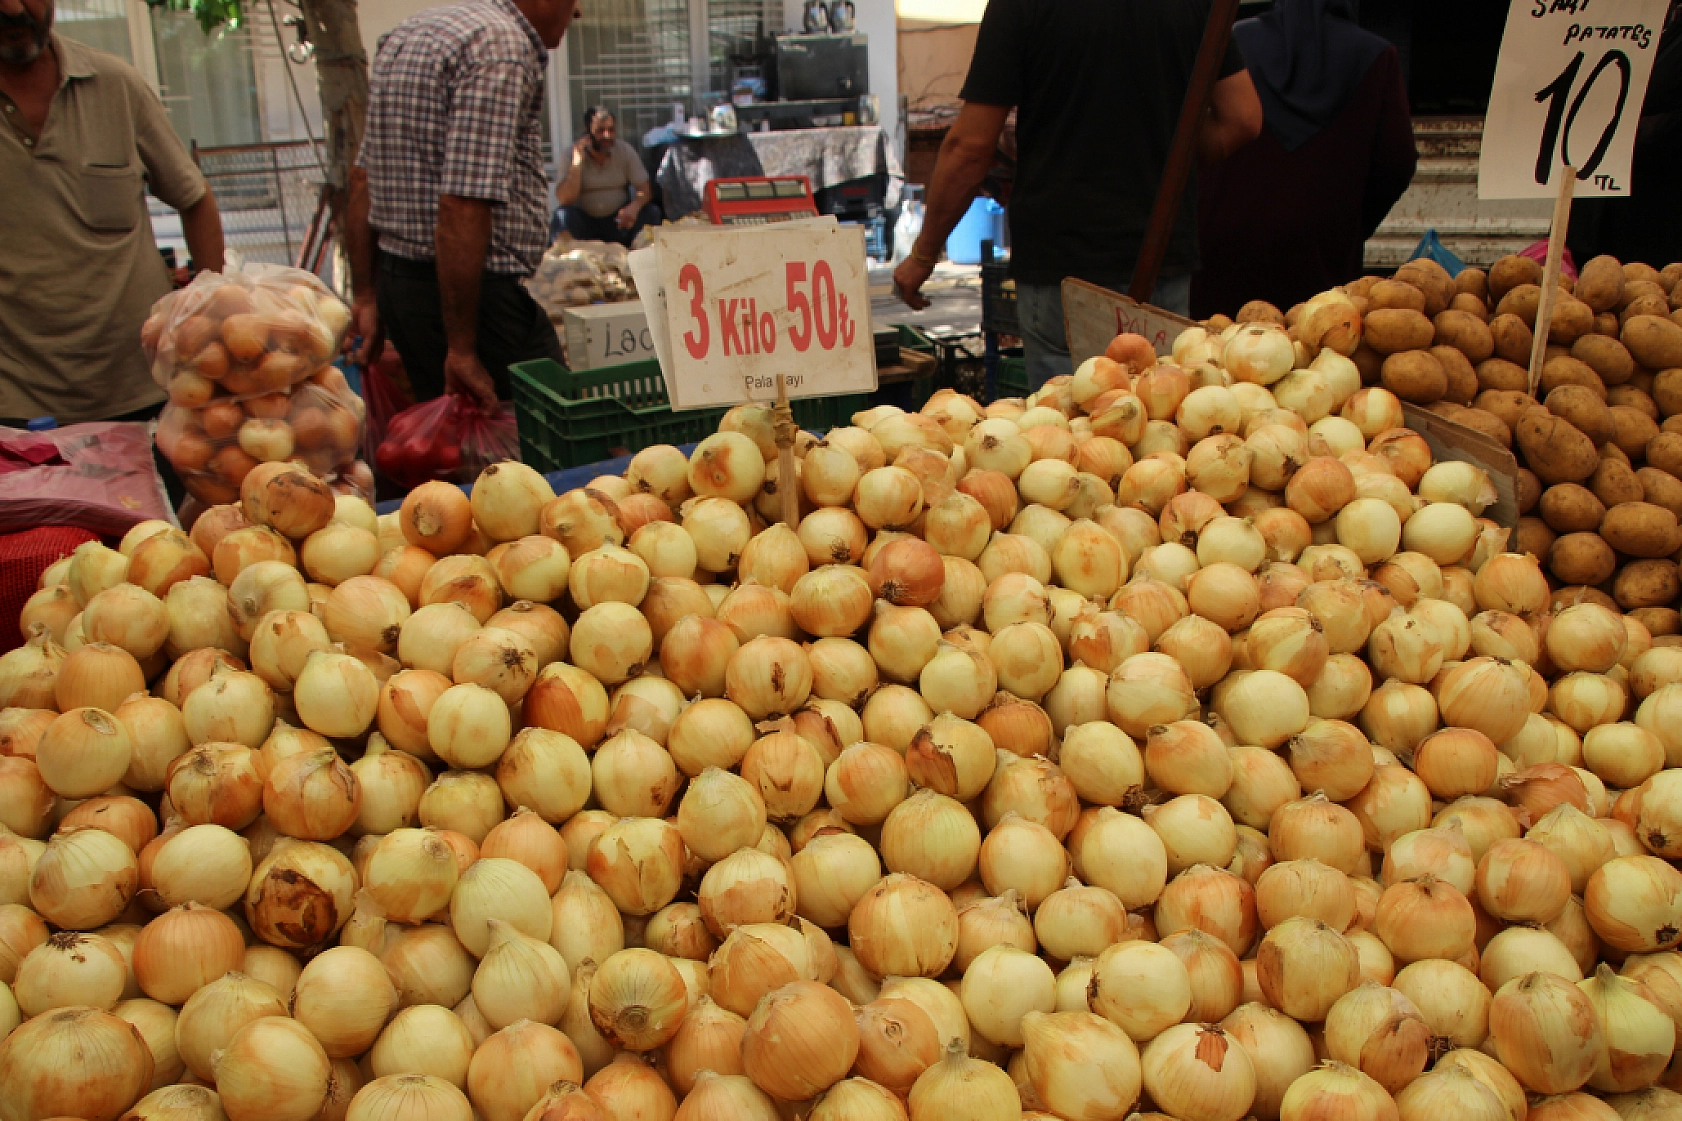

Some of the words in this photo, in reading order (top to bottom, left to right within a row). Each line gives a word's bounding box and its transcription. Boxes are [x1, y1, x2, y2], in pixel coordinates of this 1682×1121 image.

[1562, 23, 1652, 49] PATATES
[1534, 49, 1631, 185] 10
[1594, 174, 1621, 191] TL
[678, 263, 710, 360] 3
[719, 297, 776, 356] Kilo
[744, 375, 773, 390] Pala
